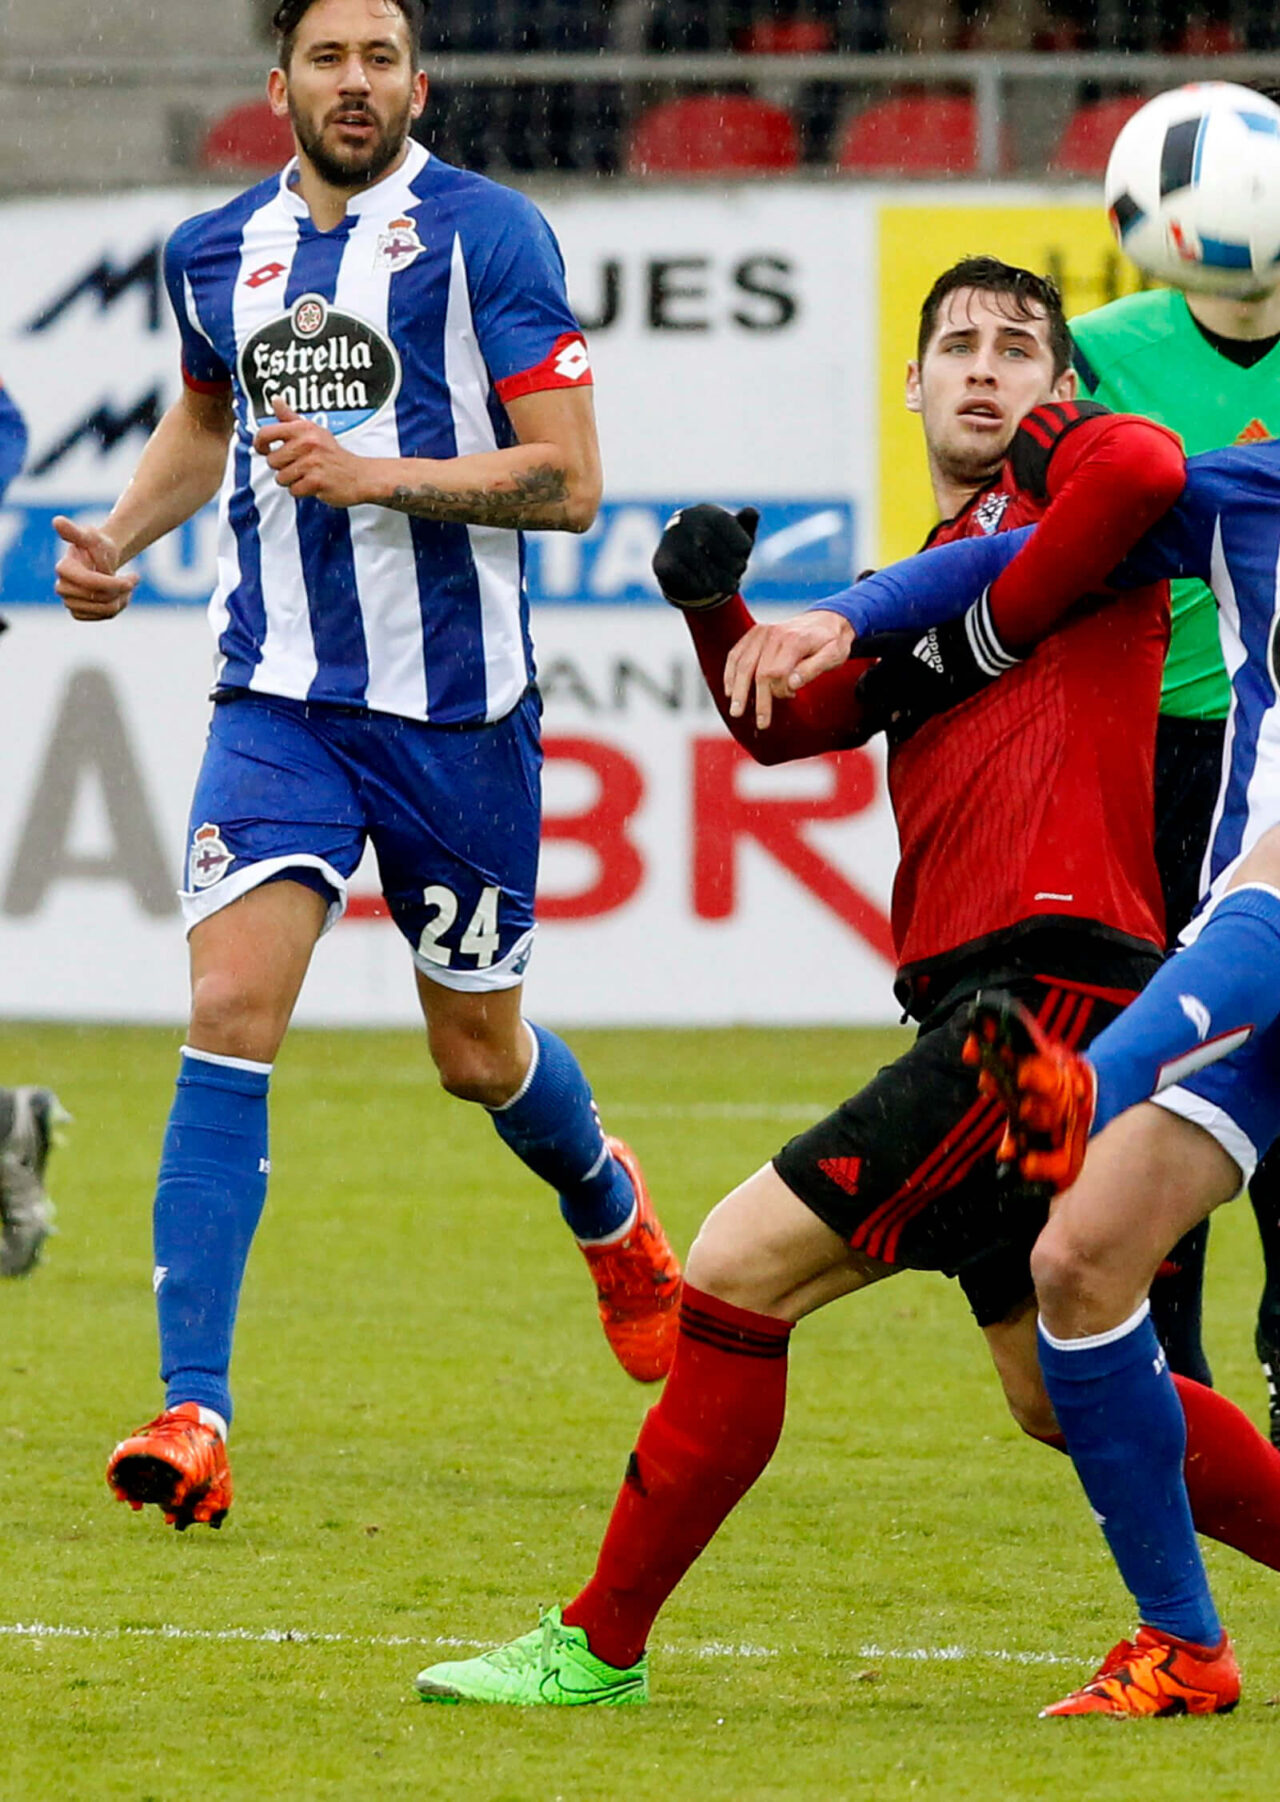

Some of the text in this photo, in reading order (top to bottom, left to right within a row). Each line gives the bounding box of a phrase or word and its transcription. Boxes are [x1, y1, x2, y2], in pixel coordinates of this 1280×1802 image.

[253, 335, 373, 379] Estrella
[262, 371, 369, 416] Galicia
[418, 885, 501, 969] 24
